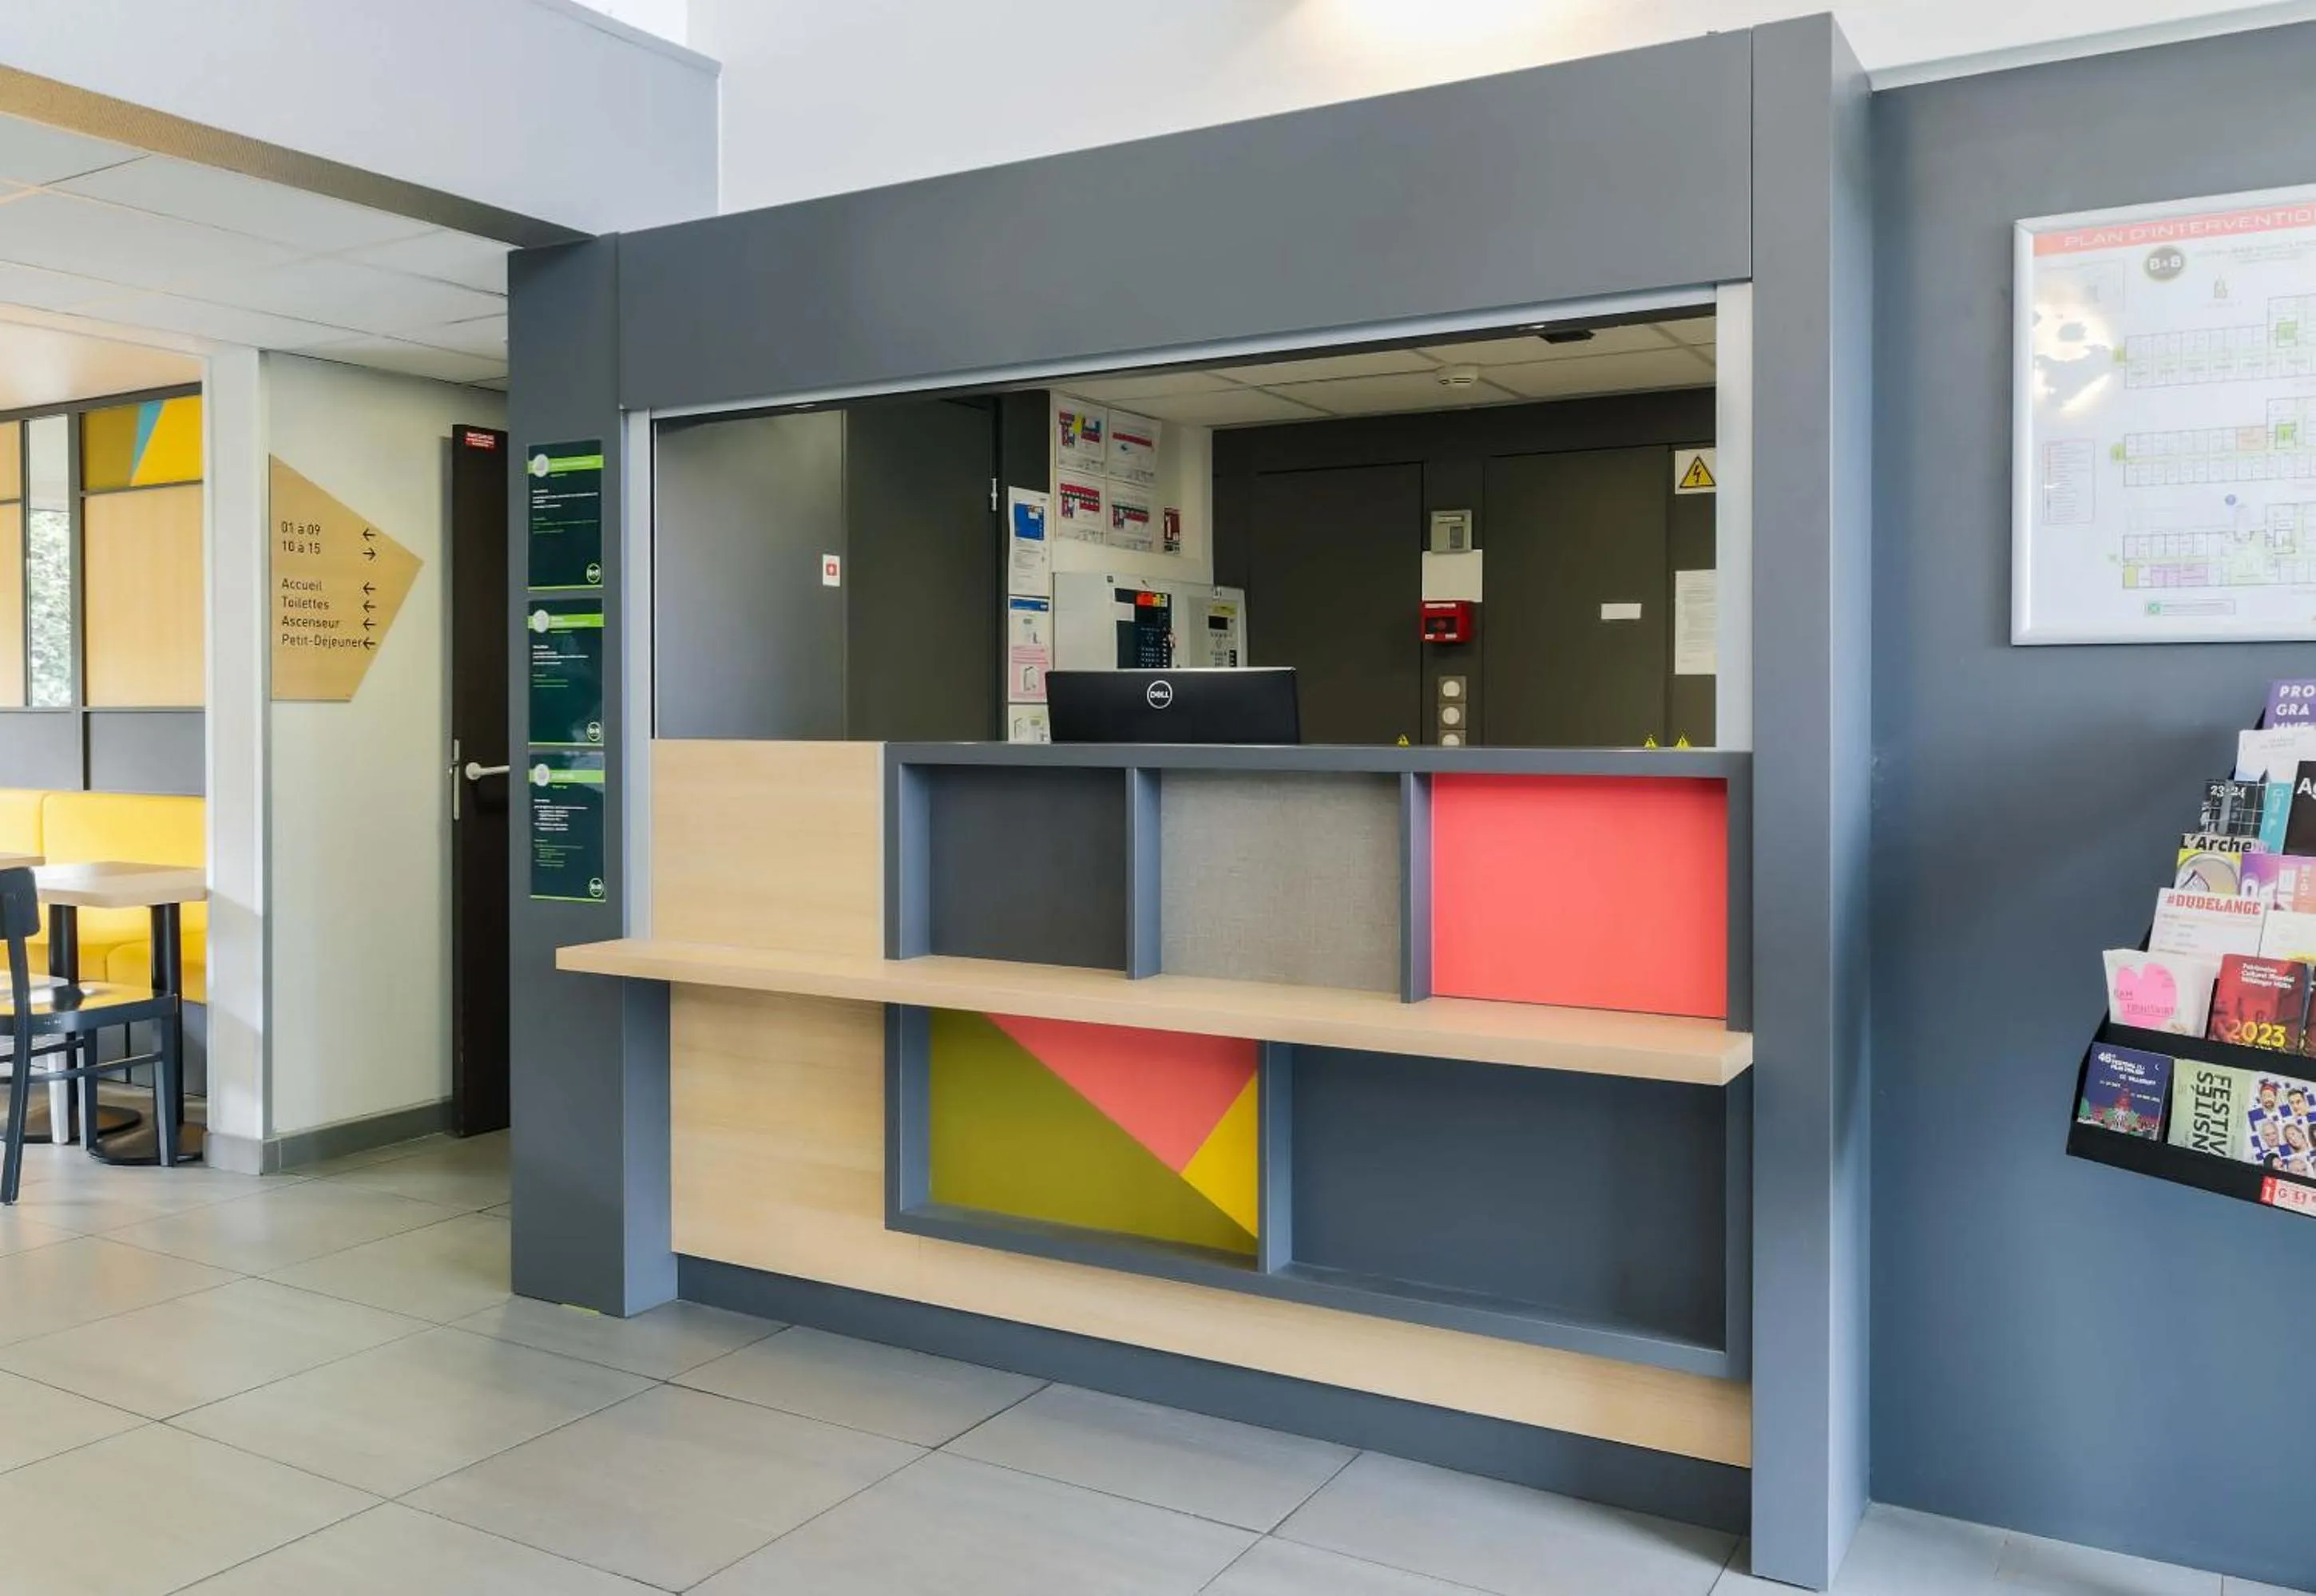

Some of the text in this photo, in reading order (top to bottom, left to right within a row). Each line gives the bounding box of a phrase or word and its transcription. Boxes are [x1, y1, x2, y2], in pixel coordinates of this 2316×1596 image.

[2063, 208, 2316, 248] PLAN D'INTERVENTIO
[281, 521, 294, 534] 01
[307, 524, 321, 536] 09
[282, 541, 295, 552] 10
[308, 542, 321, 554] 15
[282, 578, 323, 591] Accueil
[281, 596, 330, 610] Toilettes
[281, 616, 340, 628] Ascenseur
[2279, 685, 2315, 698] PRO
[2276, 703, 2310, 715] GRA
[2167, 893, 2261, 915] #DUDELANGE
[2225, 1019, 2286, 1047] 2023
